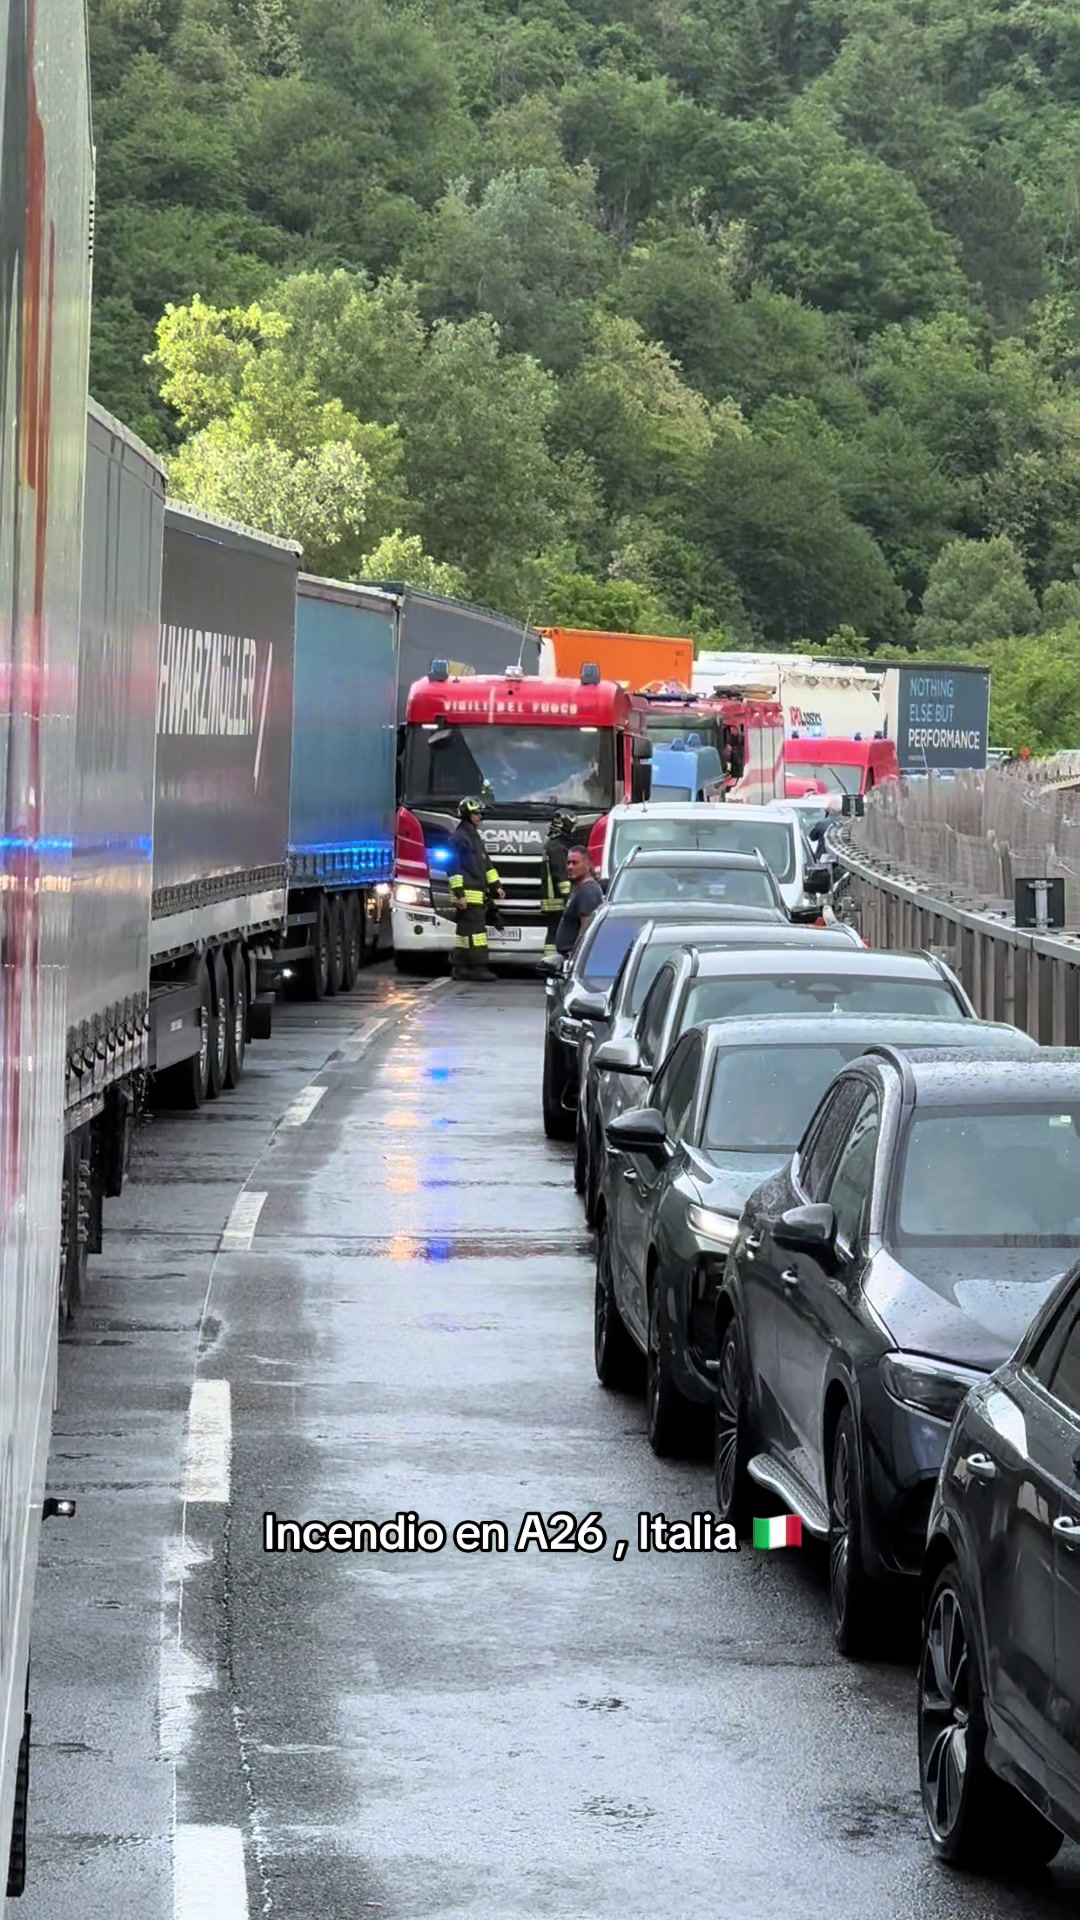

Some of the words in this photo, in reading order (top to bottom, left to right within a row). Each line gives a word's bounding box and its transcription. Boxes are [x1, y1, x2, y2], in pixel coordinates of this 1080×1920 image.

[910, 678, 954, 698] NOTHING
[443, 700, 488, 712] VIGILI
[496, 700, 524, 713] DEL
[532, 702, 578, 715] FUOCO
[909, 703, 933, 722] ELSE
[935, 704, 955, 723] BUT
[908, 728, 980, 750] PERFORMANCE
